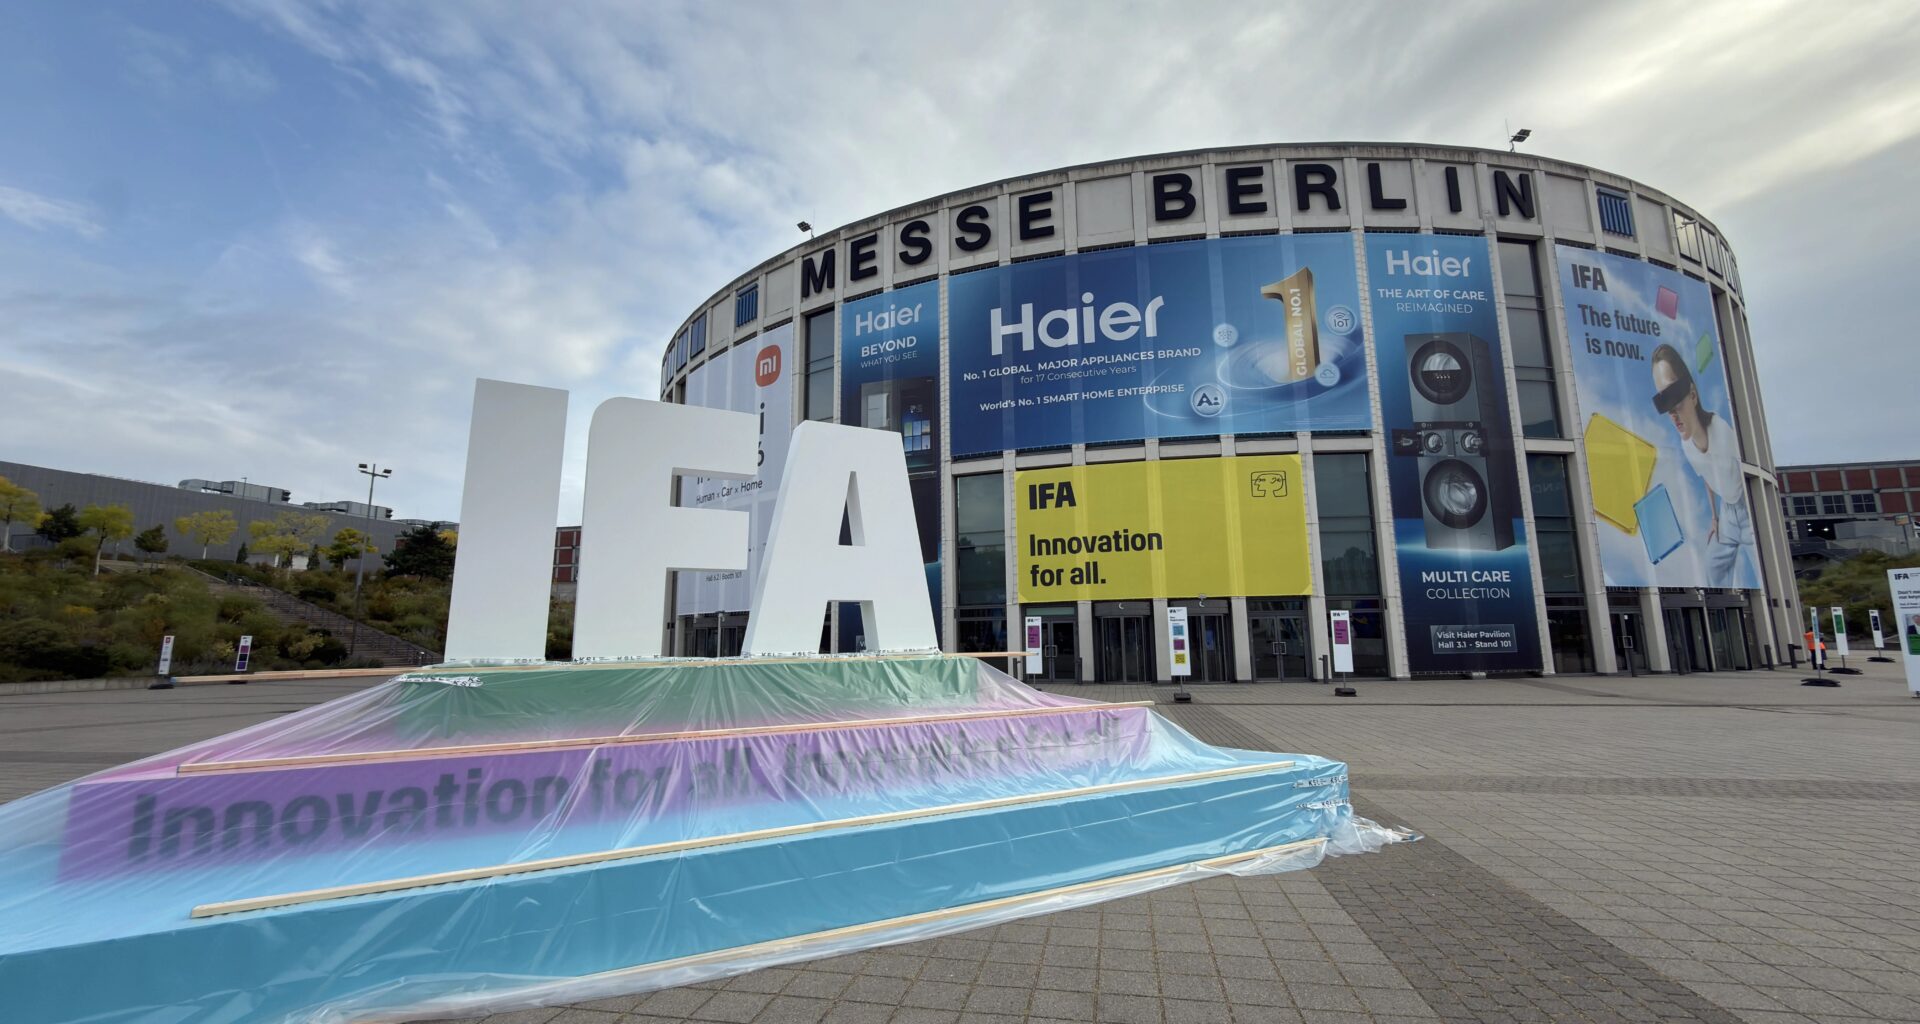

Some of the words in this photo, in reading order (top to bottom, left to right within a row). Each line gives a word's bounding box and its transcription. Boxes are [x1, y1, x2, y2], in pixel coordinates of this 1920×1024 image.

[801, 191, 1055, 298] MESSE
[1153, 162, 1536, 221] BERLIN
[1386, 249, 1471, 277] Haier
[1571, 264, 1608, 293] IFA
[1290, 288, 1302, 317] NO.1
[1378, 288, 1402, 298] THE
[1406, 289, 1431, 298] ART
[1434, 290, 1450, 299] OF
[1453, 290, 1488, 302] CARE,
[1396, 302, 1473, 314] REIMAGINED
[856, 302, 922, 336] Haier
[990, 292, 1164, 356] Haier
[1333, 318, 1350, 328] IoT
[1577, 303, 1612, 329] The
[1614, 309, 1661, 337] future
[861, 358, 882, 368] WHAT
[884, 353, 900, 364] YOU
[902, 350, 918, 360] SEE
[862, 336, 917, 358] BEYOND
[1292, 323, 1308, 376] GLOBAL
[1585, 332, 1602, 355] is
[1605, 340, 1645, 361] now.
[963, 372, 980, 381] No.
[982, 370, 987, 379] 1
[989, 364, 1032, 378] GLOBAL
[1038, 358, 1078, 372] MAJOR
[1081, 350, 1155, 366] APPLIANCES
[1158, 347, 1201, 360] BRAND
[1020, 374, 1034, 384] for
[1036, 372, 1045, 382] 17
[1047, 366, 1108, 381] Consecutive
[1109, 364, 1137, 376] Years
[980, 398, 1016, 412] World's
[1018, 396, 1034, 407] No.
[1036, 396, 1041, 404] 1
[1043, 392, 1080, 404] SMART
[1082, 389, 1115, 400] HOME
[1117, 383, 1185, 398] ENTERPRISE
[696, 492, 716, 504] Human
[722, 487, 732, 498] Car
[740, 479, 762, 492] Home
[1028, 481, 1076, 510] IFA
[444, 377, 938, 663] IFA
[1030, 529, 1163, 556] Innovation
[1030, 564, 1063, 587] for
[1070, 561, 1107, 586] all.
[1422, 570, 1468, 583] MULTI
[1472, 570, 1511, 582] CARE
[1426, 587, 1510, 600] COLLECTION
[1436, 630, 1455, 640] Visit
[1456, 630, 1478, 639] Haier
[1480, 630, 1511, 639] Pavilion
[1438, 641, 1454, 649] Hall
[1475, 640, 1498, 648] Stand
[127, 768, 571, 861] Innovation
[589, 758, 672, 814] for
